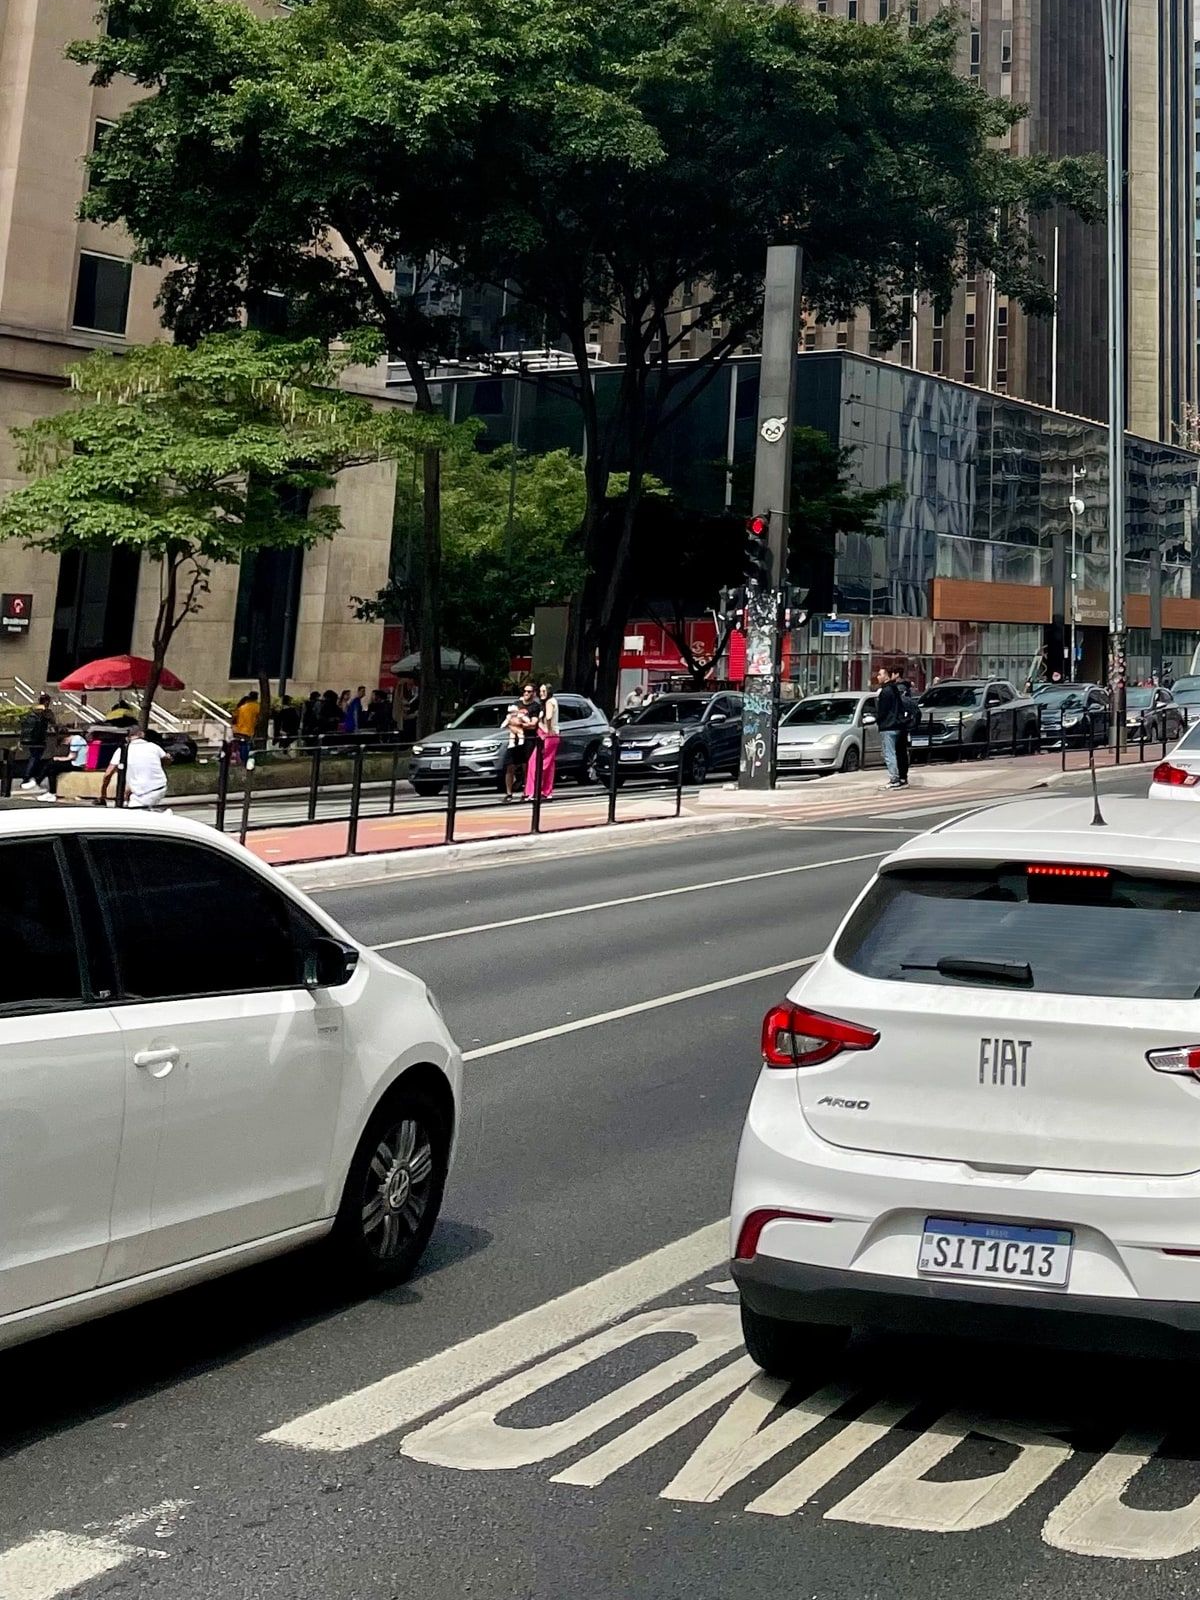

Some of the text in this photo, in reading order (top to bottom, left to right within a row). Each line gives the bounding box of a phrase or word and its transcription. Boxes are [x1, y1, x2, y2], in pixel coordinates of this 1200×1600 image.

[979, 1038, 1032, 1087] FIAT
[817, 1096, 870, 1111] ARGO
[934, 1236, 1055, 1277] SIT1C13
